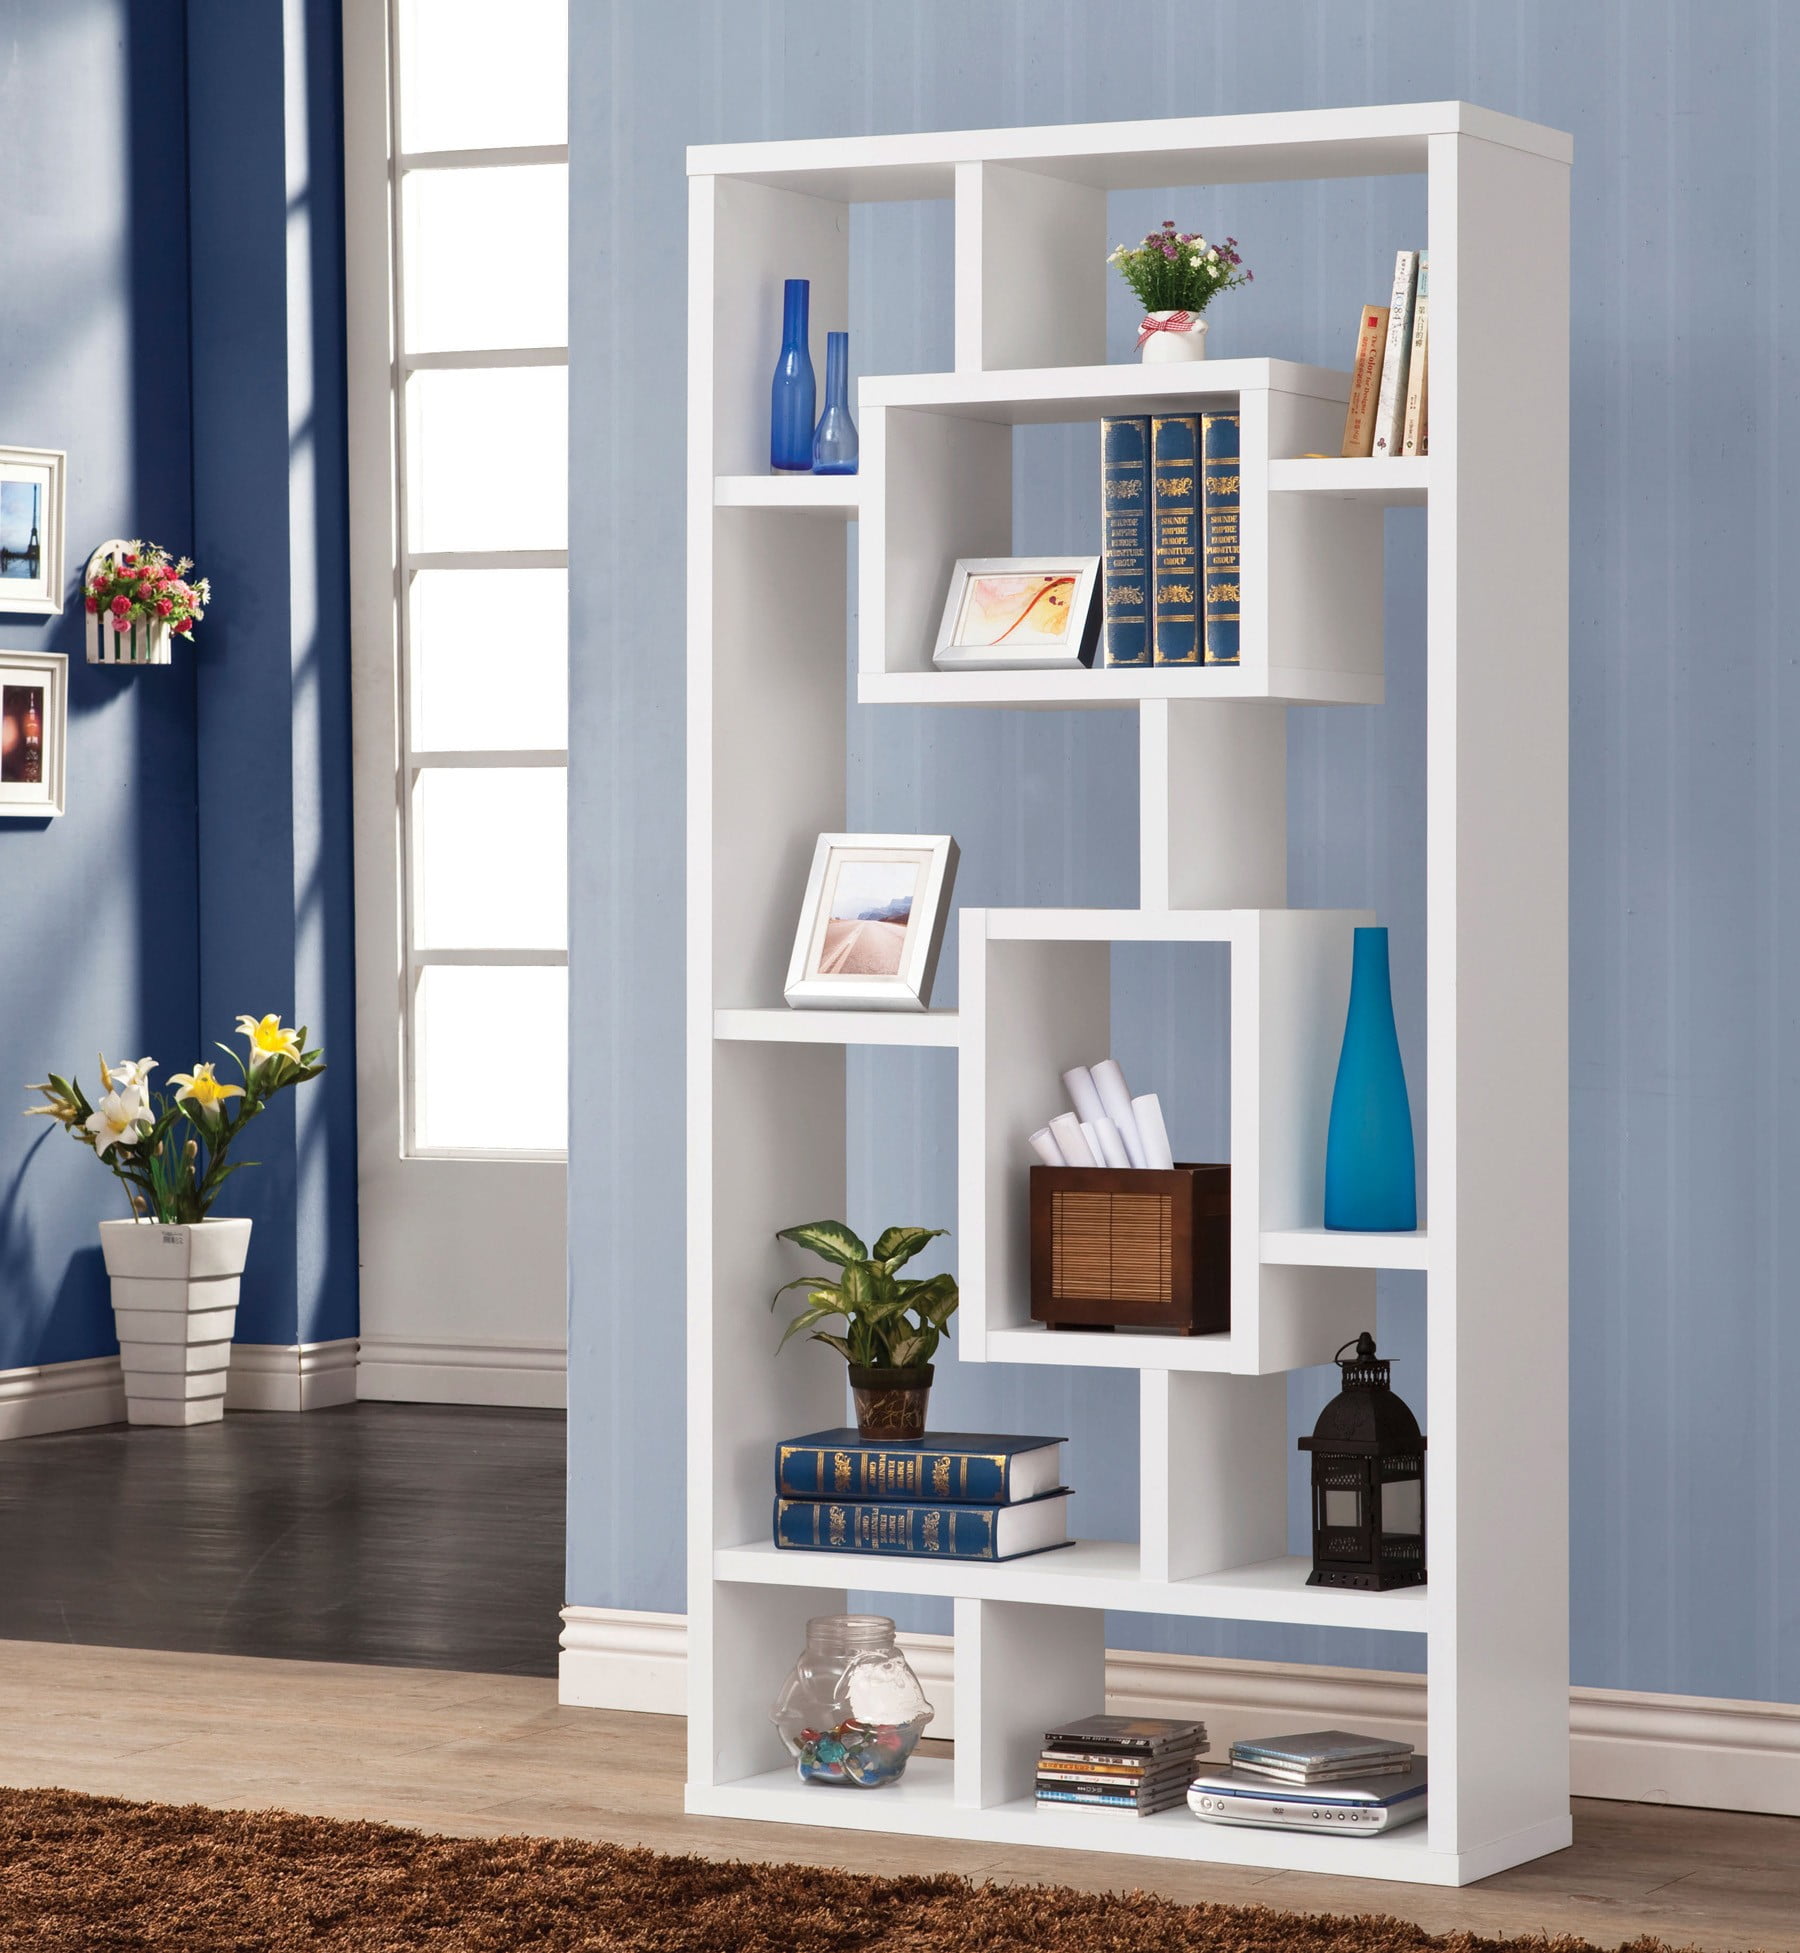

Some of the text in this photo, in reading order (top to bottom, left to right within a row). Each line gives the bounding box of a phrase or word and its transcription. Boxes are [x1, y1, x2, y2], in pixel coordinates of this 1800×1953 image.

[1367, 348, 1377, 374] Color
[1361, 387, 1370, 415] Designer
[1162, 537, 1188, 545] EUROPE
[1106, 549, 1144, 557] FURNITURE
[1158, 547, 1194, 555] FURNITURE
[1164, 557, 1186, 565] GROUP
[1214, 556, 1236, 564] GROUP
